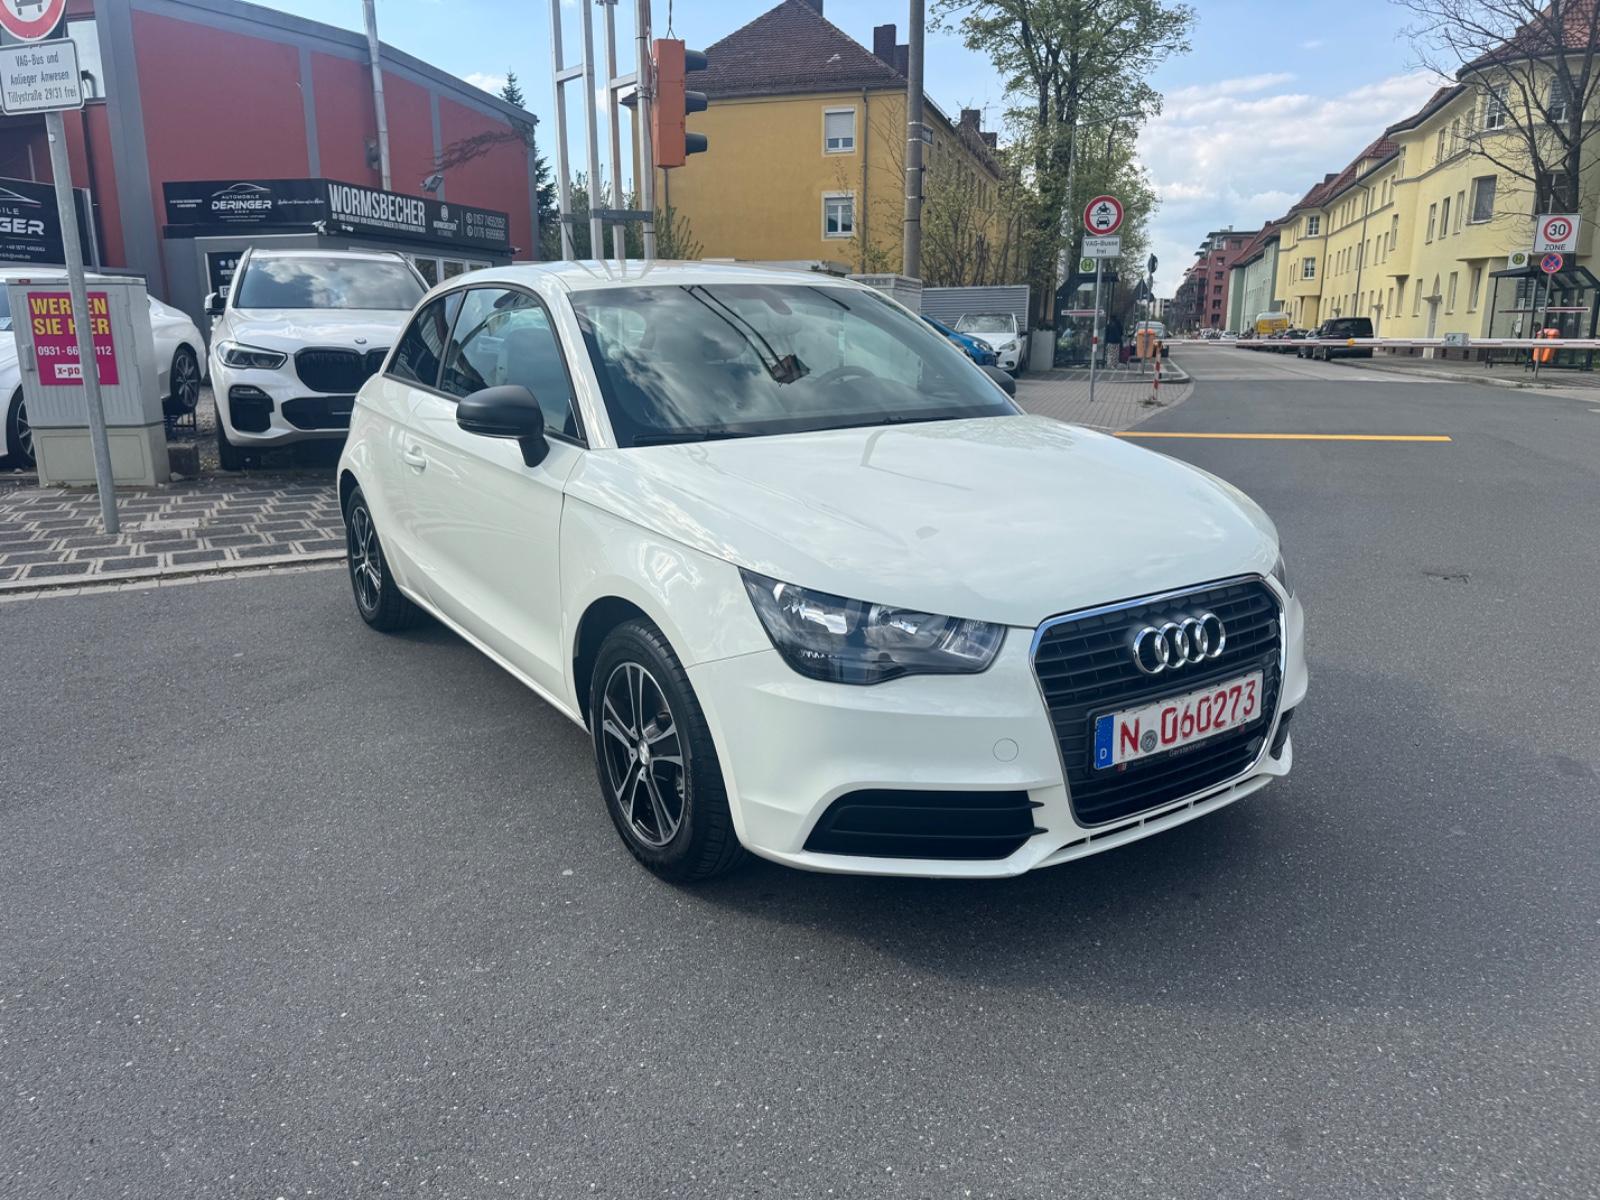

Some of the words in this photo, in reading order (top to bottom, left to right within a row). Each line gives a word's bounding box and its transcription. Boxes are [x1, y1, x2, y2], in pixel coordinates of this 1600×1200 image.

[15, 54, 44, 67] VAG-Bus
[46, 51, 59, 64] und
[10, 73, 37, 87] Anlieger
[40, 70, 69, 83] Anwesen
[8, 89, 42, 104] Tillystraße
[44, 87, 61, 101] 29/31
[64, 85, 77, 98] frei
[211, 199, 272, 210] DERINGER
[328, 183, 426, 226] WORMSBECHER
[1549, 223, 1566, 237] 30
[1544, 243, 1567, 251] ZONE
[30, 298, 107, 315] WEREN
[33, 318, 63, 335] SIE
[68, 318, 110, 335] HER
[1120, 717, 1141, 755] N
[1160, 679, 1256, 745] 060273
[1100, 748, 1107, 759] D
